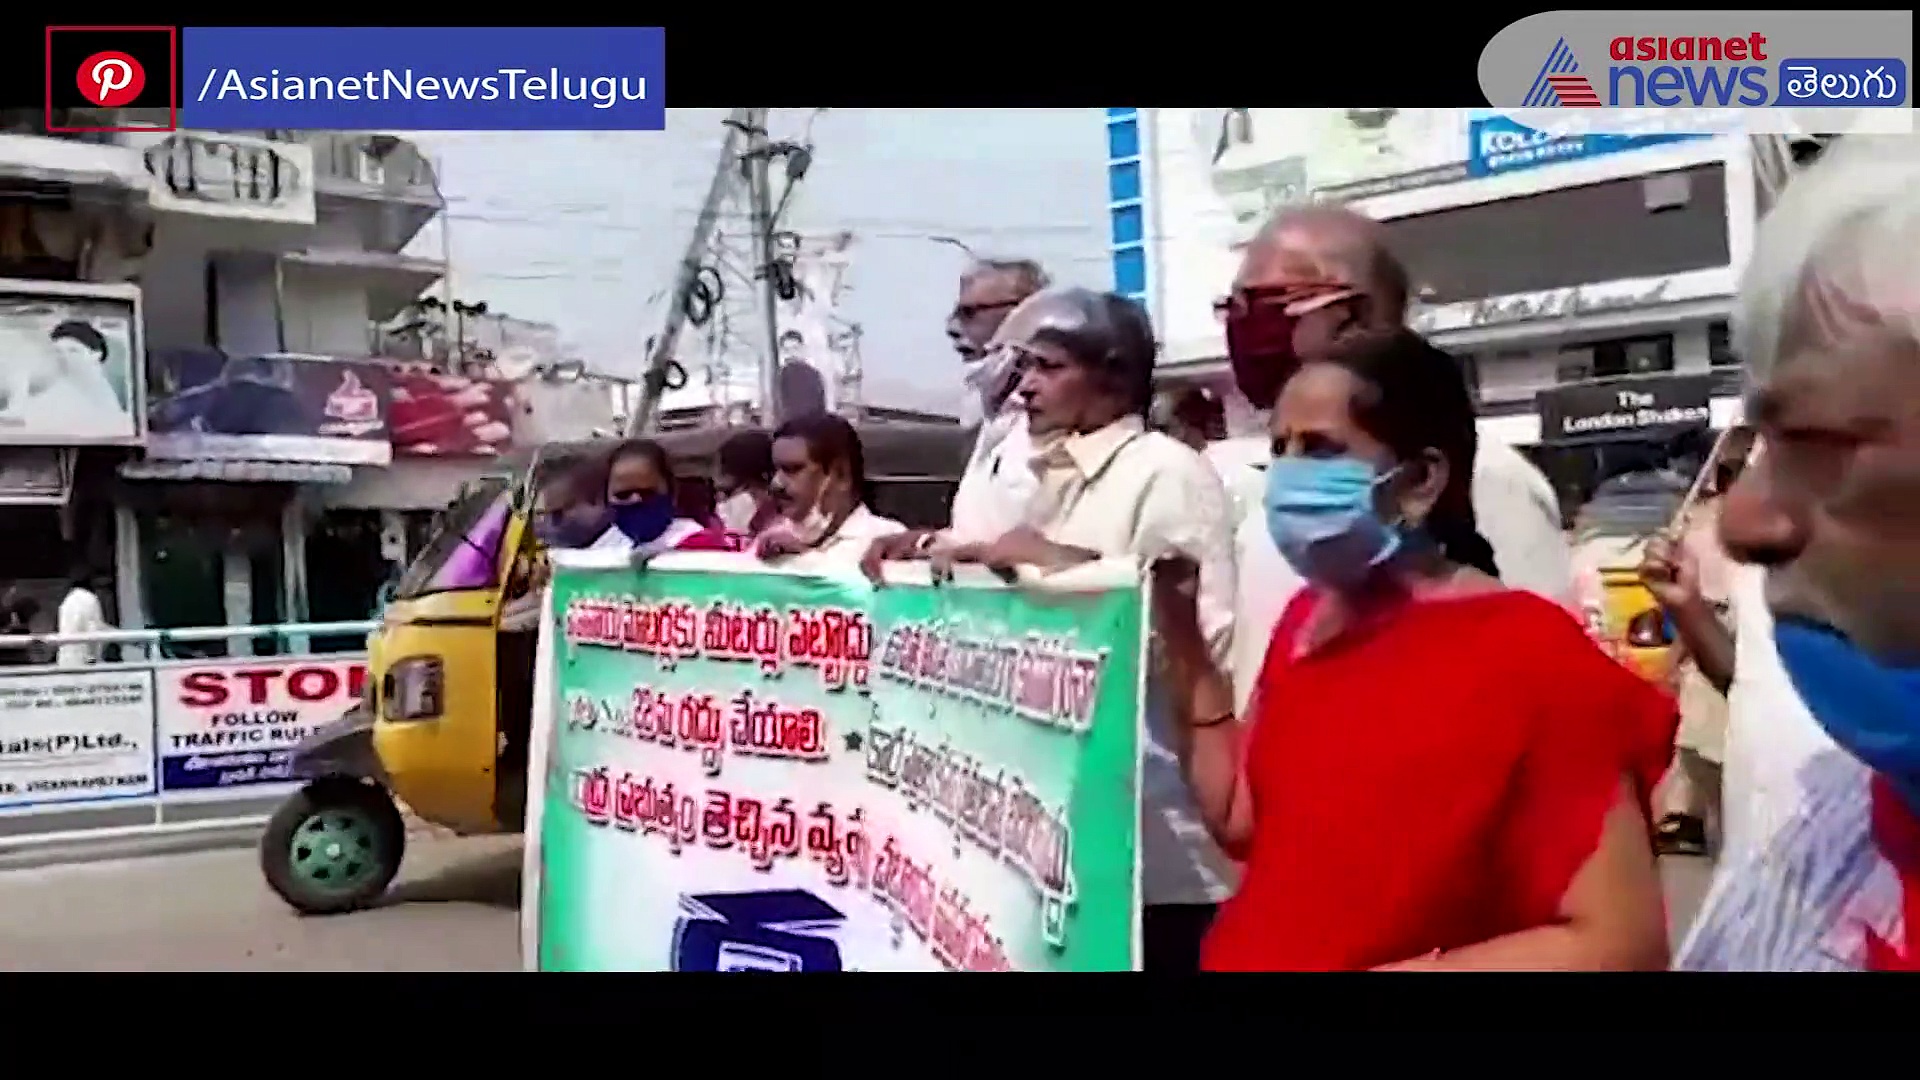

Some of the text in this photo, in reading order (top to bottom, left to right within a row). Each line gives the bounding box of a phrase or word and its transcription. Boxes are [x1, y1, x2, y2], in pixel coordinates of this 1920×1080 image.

[1563, 411, 1635, 433] London
[211, 711, 299, 728] FOLLOW
[171, 729, 264, 748] TRAFFIC
